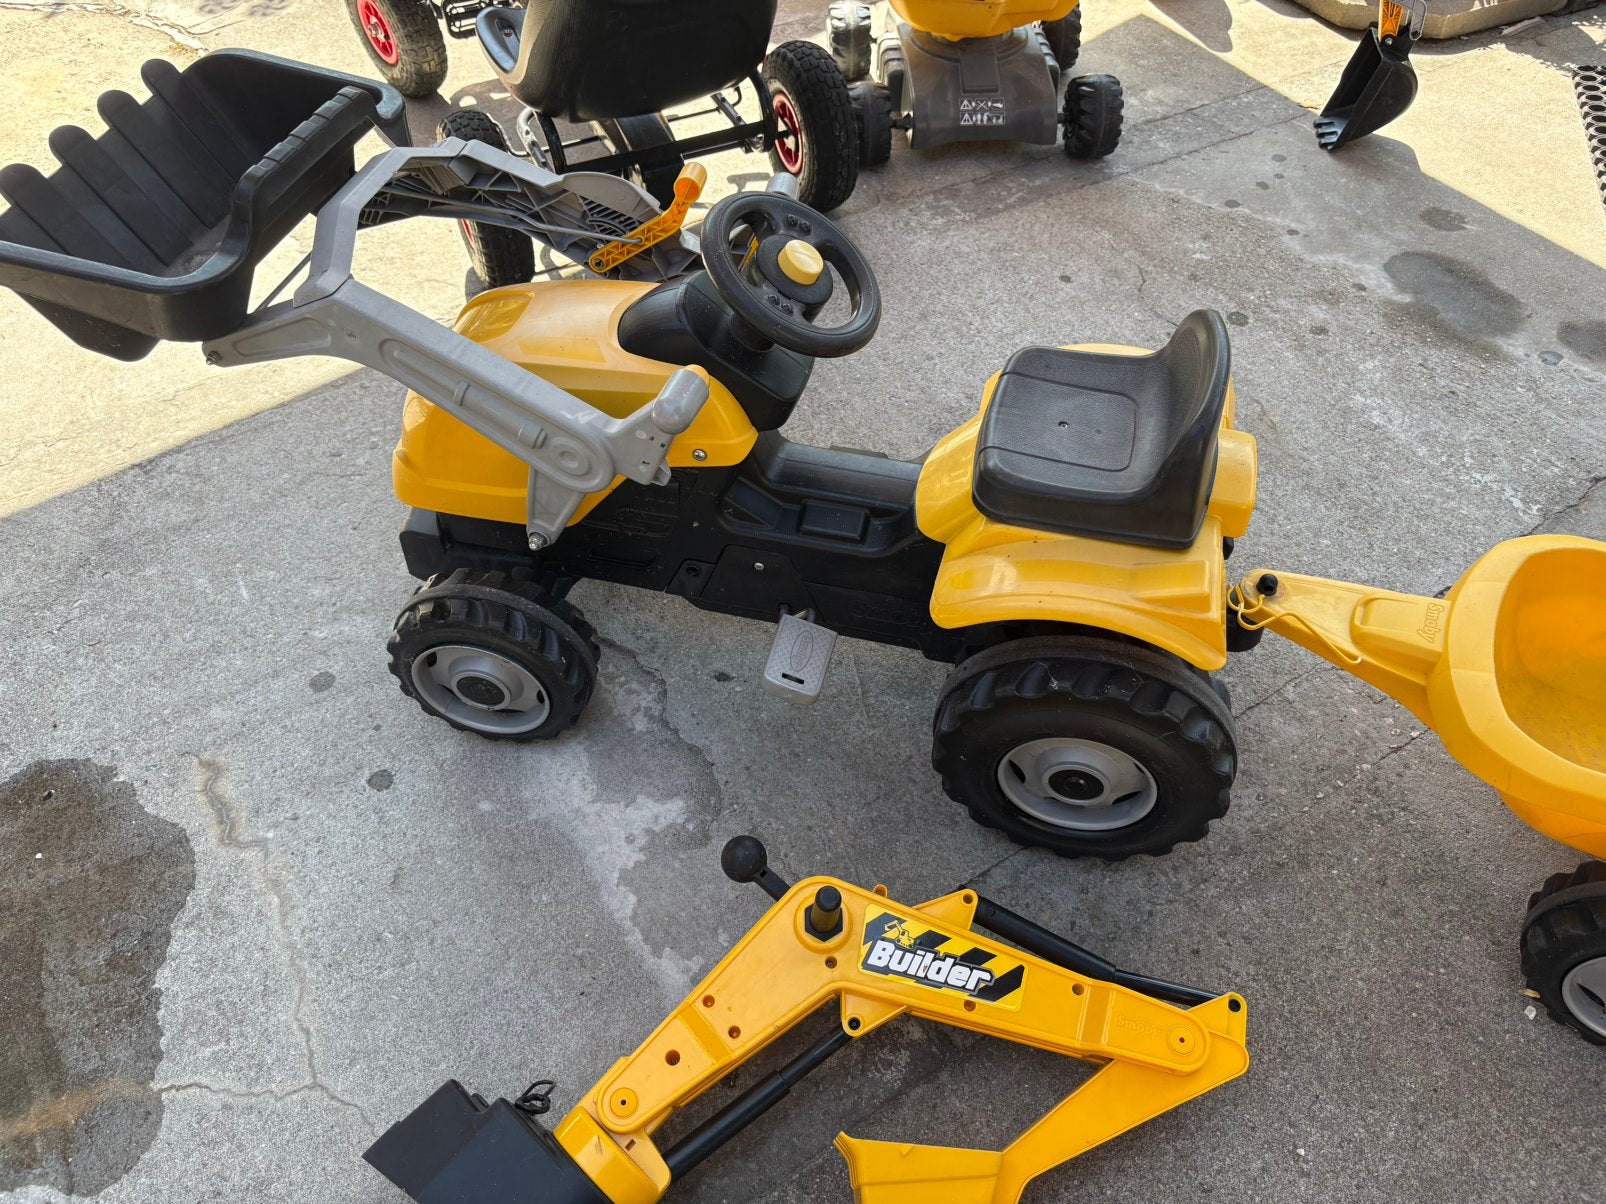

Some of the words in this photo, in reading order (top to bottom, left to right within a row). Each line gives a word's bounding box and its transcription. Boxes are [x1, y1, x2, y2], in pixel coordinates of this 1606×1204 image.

[1417, 603, 1443, 644] Smoby
[867, 940, 992, 991] Builder
[1116, 1014, 1163, 1040] Smoby
